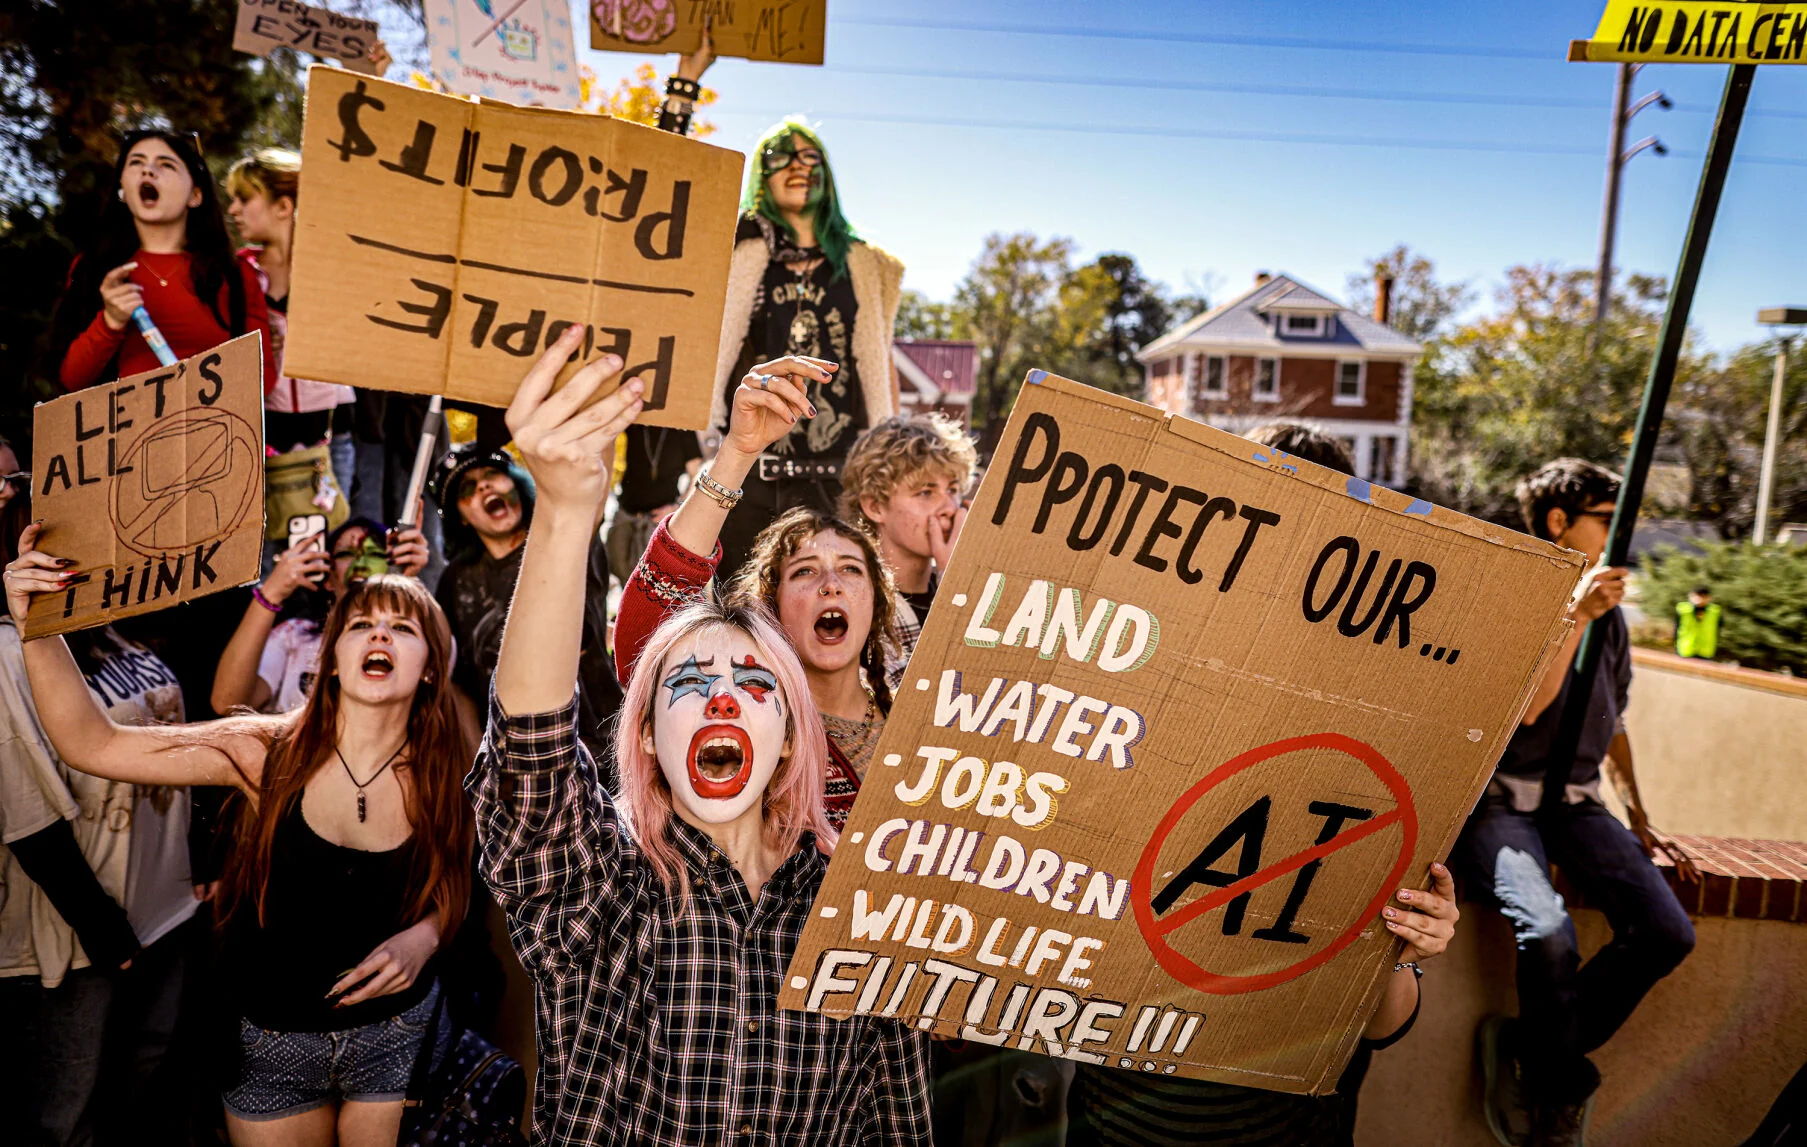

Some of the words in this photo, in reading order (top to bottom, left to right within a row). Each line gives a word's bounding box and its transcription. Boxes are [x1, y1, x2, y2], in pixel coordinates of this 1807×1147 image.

[251, 14, 366, 59] EYES
[1617, 7, 1663, 53] NO
[1664, 8, 1743, 58] DATA
[365, 277, 675, 412] PEOPLE
[75, 353, 224, 442] LET'S
[41, 438, 134, 496] ALL
[963, 572, 1161, 673] LAND
[933, 669, 1147, 772] WATER
[894, 745, 1072, 832] JOBS
[863, 818, 1133, 921] CHILDREN
[1150, 795, 1377, 944] AI
